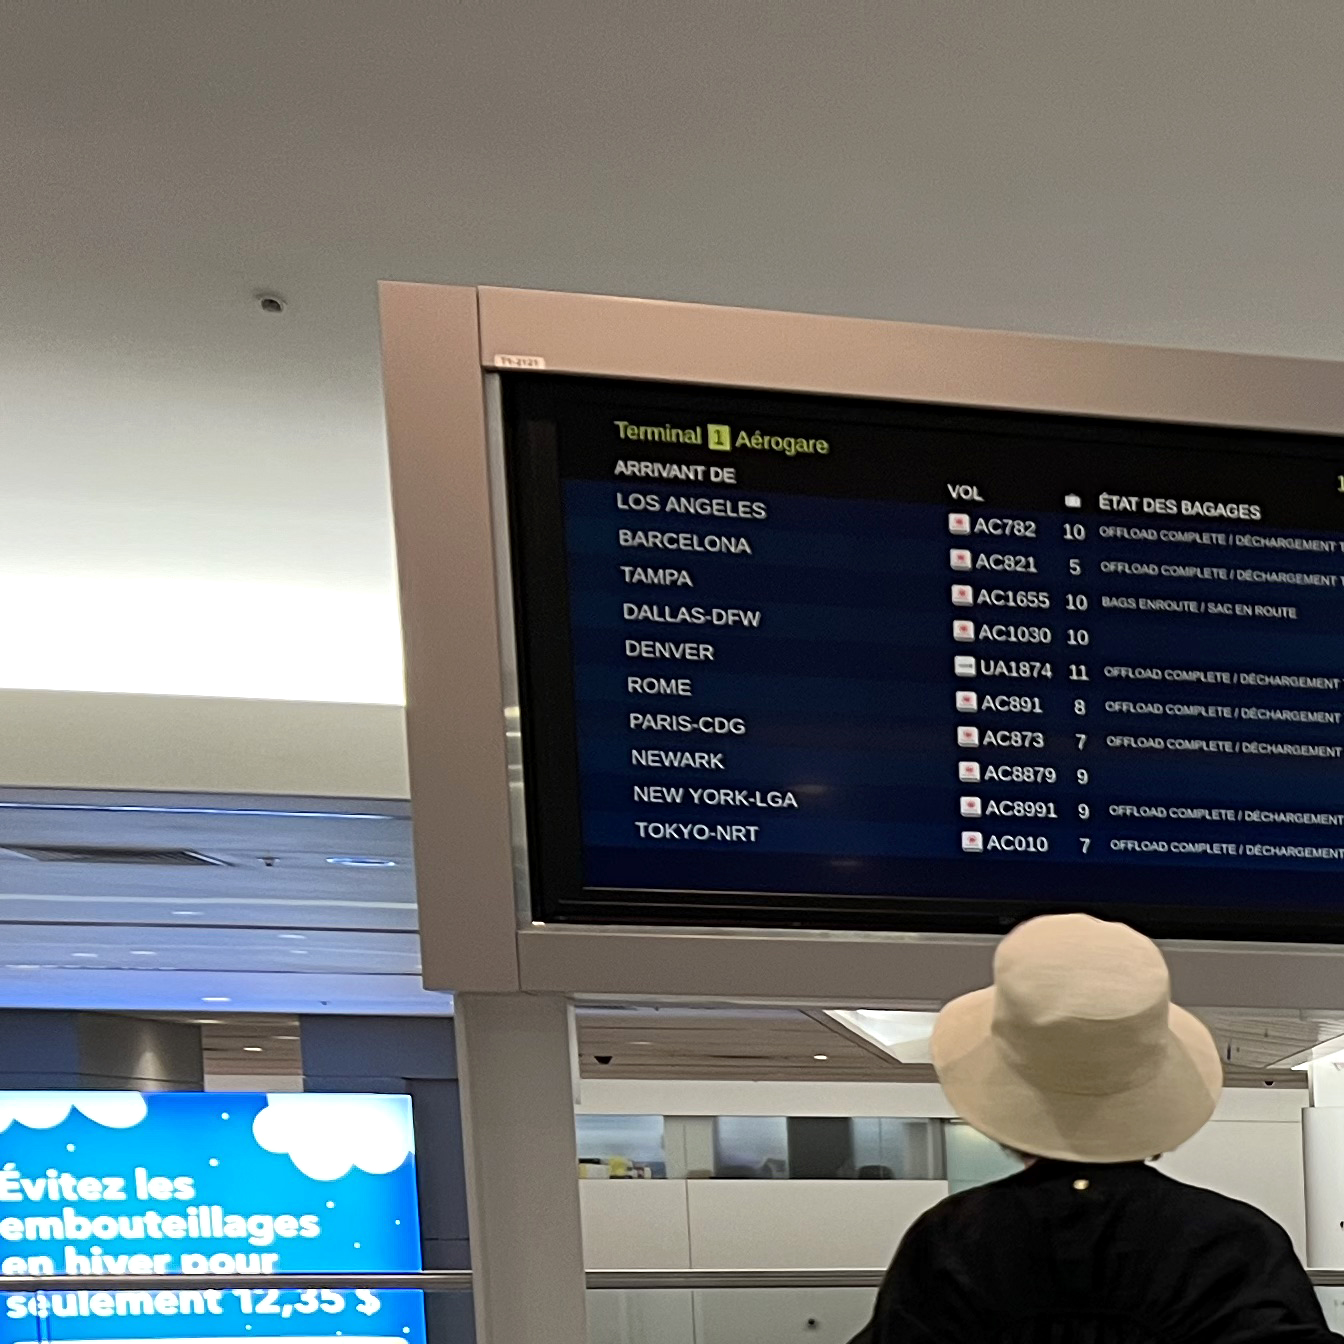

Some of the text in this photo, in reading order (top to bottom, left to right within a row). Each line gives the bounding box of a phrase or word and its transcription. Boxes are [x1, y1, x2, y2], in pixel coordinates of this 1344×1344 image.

[612, 419, 703, 445] Terminal
[735, 428, 829, 455] Aérogare
[614, 460, 737, 484] ARRIVANT DE
[947, 484, 984, 501] VOL
[617, 492, 766, 519] LOS ANGELES
[1099, 492, 1261, 520] ÉTAT DES BAGAGES
[974, 518, 1036, 537] AC782
[619, 529, 752, 554] BARCELONA
[1099, 526, 1158, 540] OFFLOAD
[1159, 530, 1226, 545] COMPLETE
[1235, 534, 1337, 552] DÉCHARGEMENT
[976, 553, 1037, 573] AC821
[620, 566, 693, 587] TAMPA
[977, 589, 1050, 608] AC1655
[1102, 596, 1297, 619] BAGS ENROUTE SAC EN ROUTE
[623, 603, 761, 627] DALLAS-DFW
[979, 624, 1051, 643] AC1030
[625, 640, 714, 660] DENVER
[981, 659, 1052, 678] UA1874
[628, 677, 692, 696] ROME
[981, 695, 1043, 713] AC891
[630, 713, 745, 734] PARIS-CDG
[983, 730, 1044, 748] AC873
[632, 749, 725, 769] NEWARK
[984, 765, 1056, 783] AC8879
[634, 786, 798, 808] NEW YORK-LGA
[985, 800, 1058, 818] AC8991
[635, 822, 759, 841] TOKYO-NRT
[987, 835, 1048, 852] AC010
[0, 1162, 195, 1202] Évitez les
[0, 1205, 320, 1246] embouteillages
[1, 1253, 54, 1275] en
[64, 1246, 169, 1275] hiver
[5, 1289, 223, 1319] seulement
